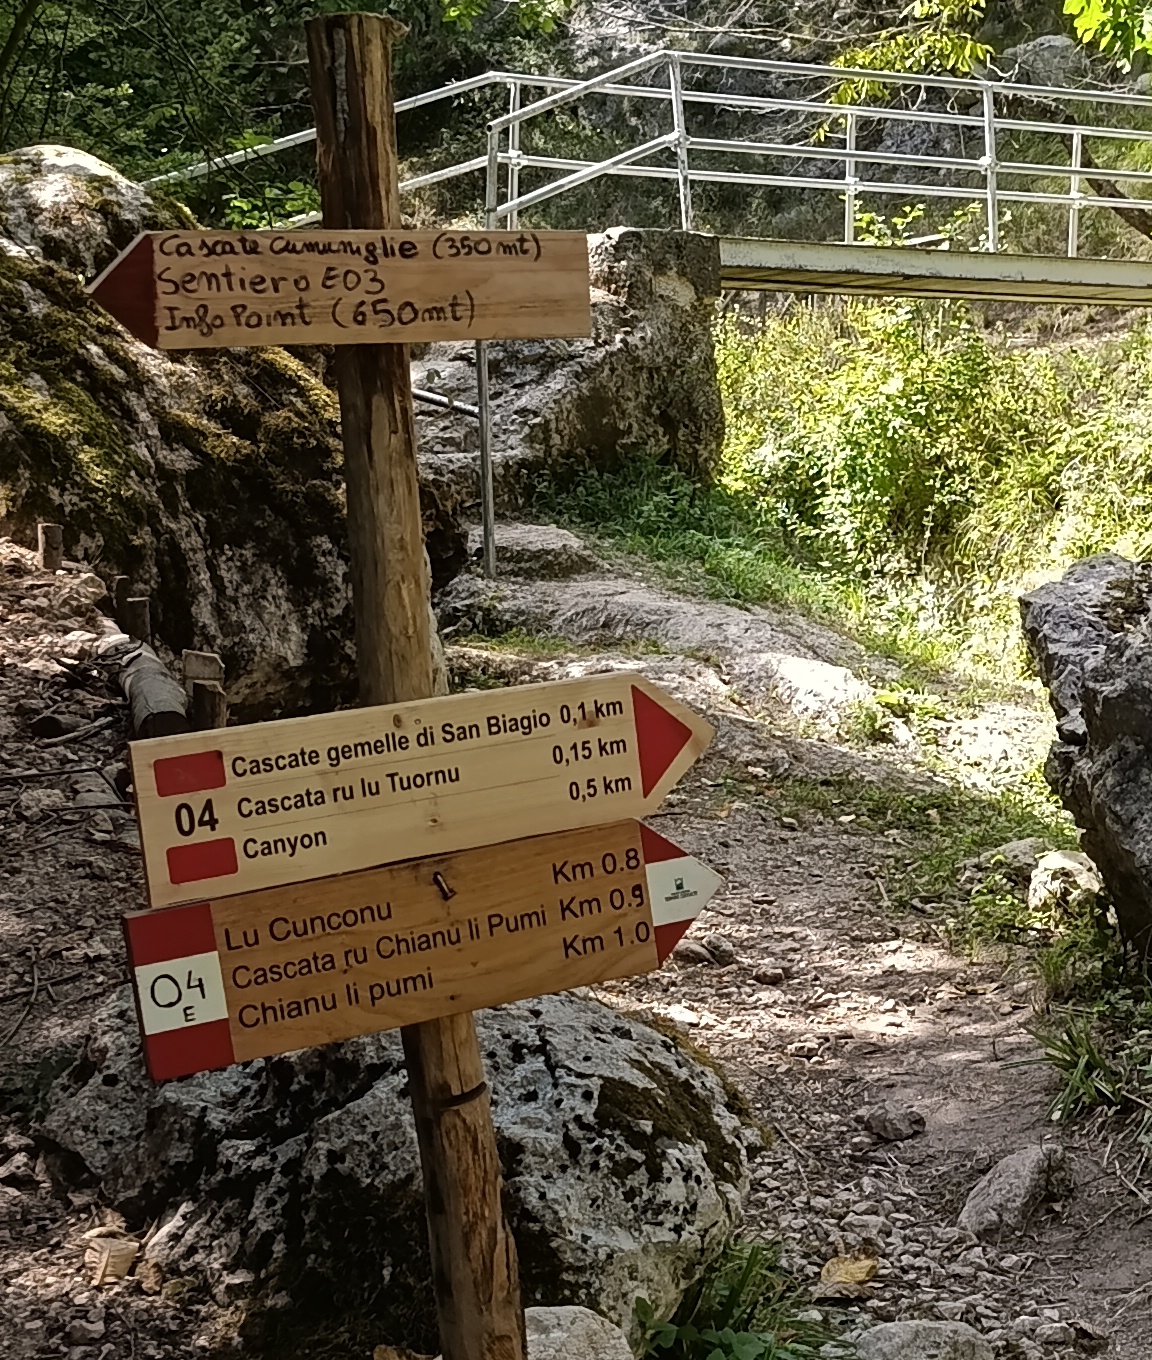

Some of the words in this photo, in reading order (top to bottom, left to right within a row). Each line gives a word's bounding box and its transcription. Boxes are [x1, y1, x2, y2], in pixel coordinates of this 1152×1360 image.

[159, 234, 263, 258] Cascate
[157, 264, 310, 295] Sentiero
[321, 266, 386, 295] E03
[559, 701, 588, 727] 0,1
[594, 699, 624, 719] km
[231, 747, 320, 778] Cascate
[327, 732, 410, 767] gemelle
[416, 726, 435, 748] di
[441, 722, 481, 744] San
[486, 709, 551, 736] Biagio
[552, 742, 593, 766] 0,15
[598, 738, 627, 757] km
[237, 788, 326, 819] Cascata
[332, 785, 355, 803] ru
[361, 777, 380, 798] lu
[386, 767, 460, 793] Tuornu
[569, 778, 597, 802] 0,5
[603, 776, 632, 795] km
[174, 798, 219, 837] 04
[243, 830, 328, 859] Canyon
[552, 860, 594, 885] Km
[601, 848, 640, 875] 0.8
[559, 896, 602, 922] Km
[609, 883, 645, 911] 0.9
[224, 927, 260, 951] Lu
[269, 901, 392, 942] Cunconu
[563, 934, 605, 959] Km
[613, 921, 651, 947] 1.0
[232, 951, 336, 990] Cascata
[344, 946, 368, 967] ru
[375, 926, 461, 960] Chianu
[468, 918, 481, 941] li
[488, 904, 547, 937] Pumi
[150, 969, 206, 1008] 04
[238, 993, 337, 1029] Chianu
[346, 982, 360, 1006] li
[369, 966, 434, 1007] pumi
[183, 1006, 196, 1023] E
